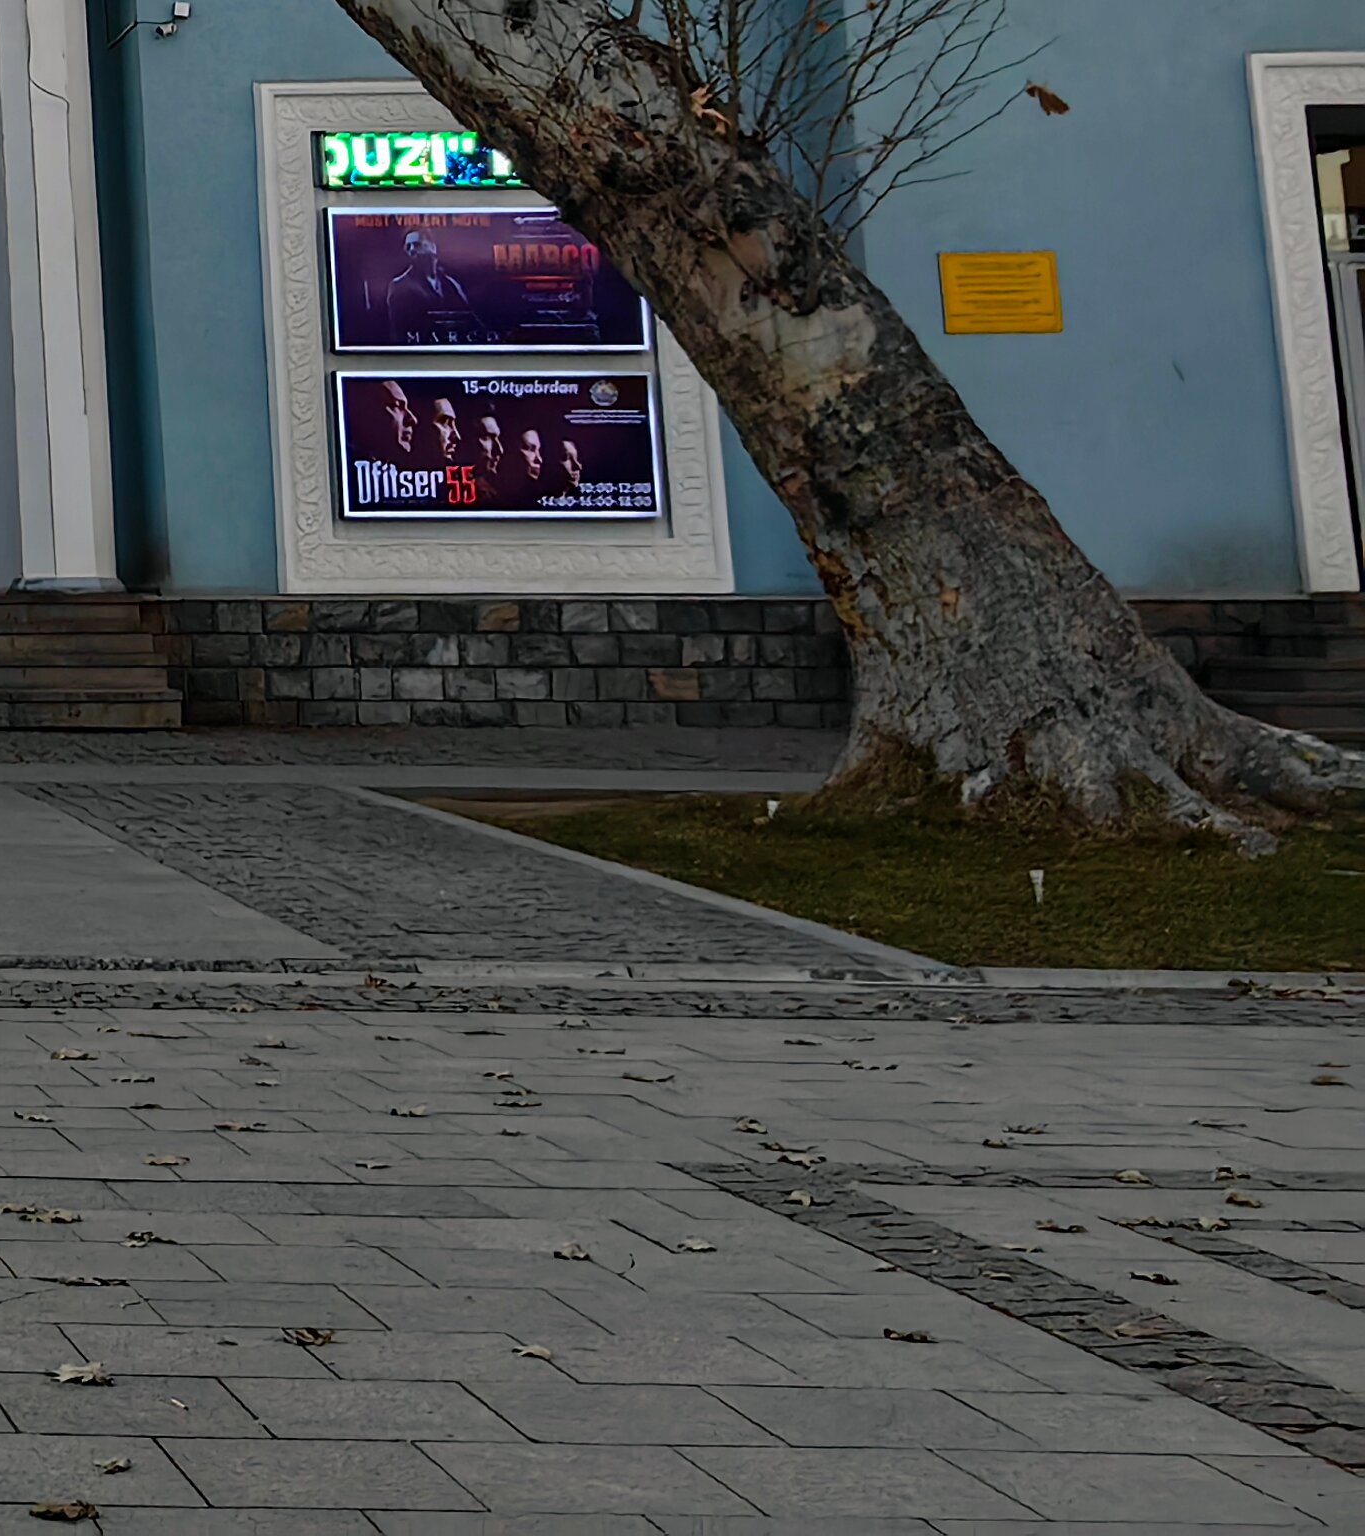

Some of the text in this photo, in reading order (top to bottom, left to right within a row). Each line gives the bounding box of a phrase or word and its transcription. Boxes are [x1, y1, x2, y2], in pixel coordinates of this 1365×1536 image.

[462, 380, 579, 397] 15-Oktyabrdan
[355, 460, 476, 504] Ofitser 55
